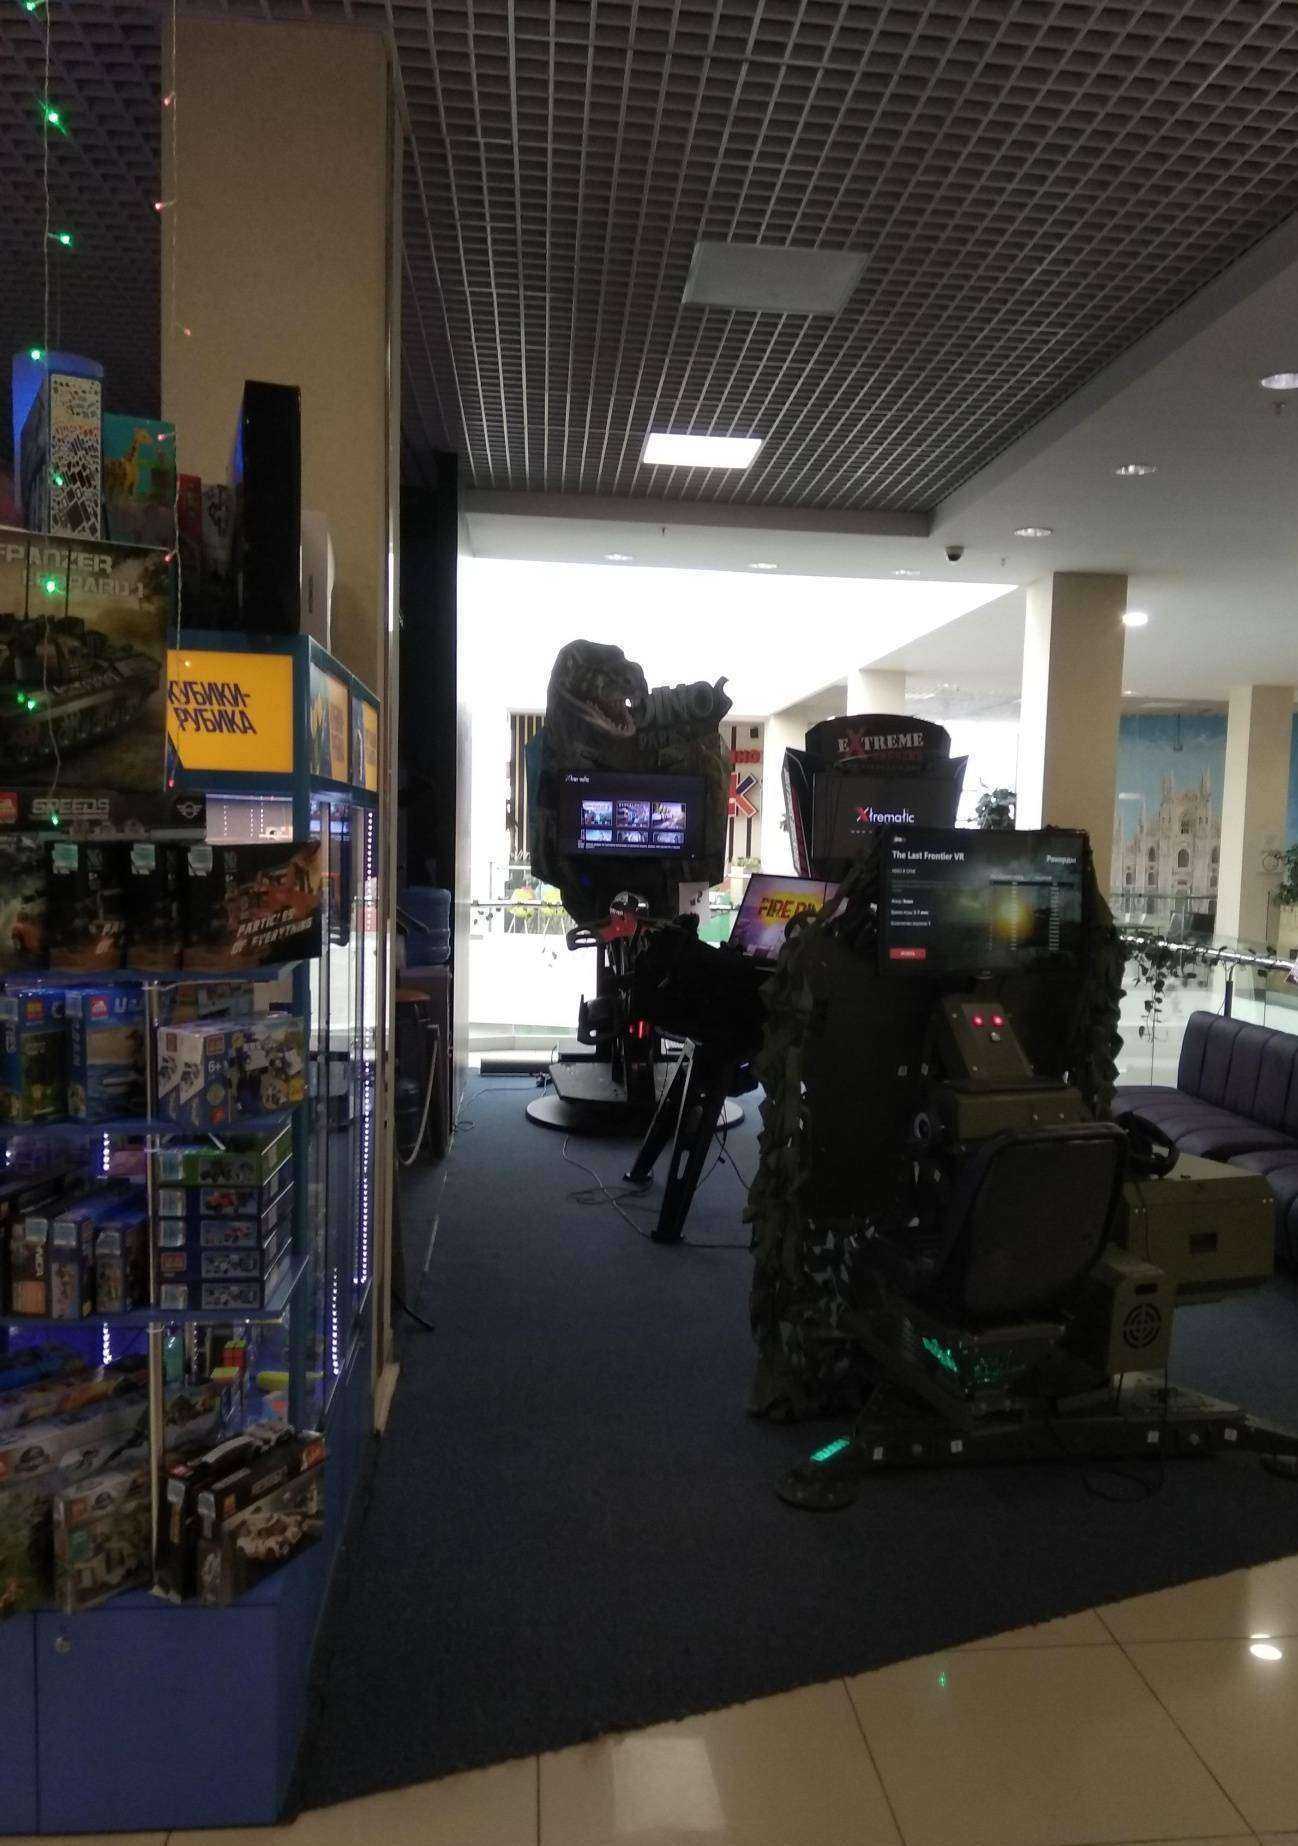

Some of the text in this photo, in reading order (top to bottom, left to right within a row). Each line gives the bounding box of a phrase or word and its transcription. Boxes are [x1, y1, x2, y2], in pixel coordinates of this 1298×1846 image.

[0, 543, 113, 575] PANZER
[168, 680, 250, 707] КУБИКИ-
[174, 707, 257, 734] РУБИКА
[838, 731, 924, 755] EXTREME
[856, 806, 915, 823] Xtrematic
[892, 851, 964, 861] The Last Frontier VR
